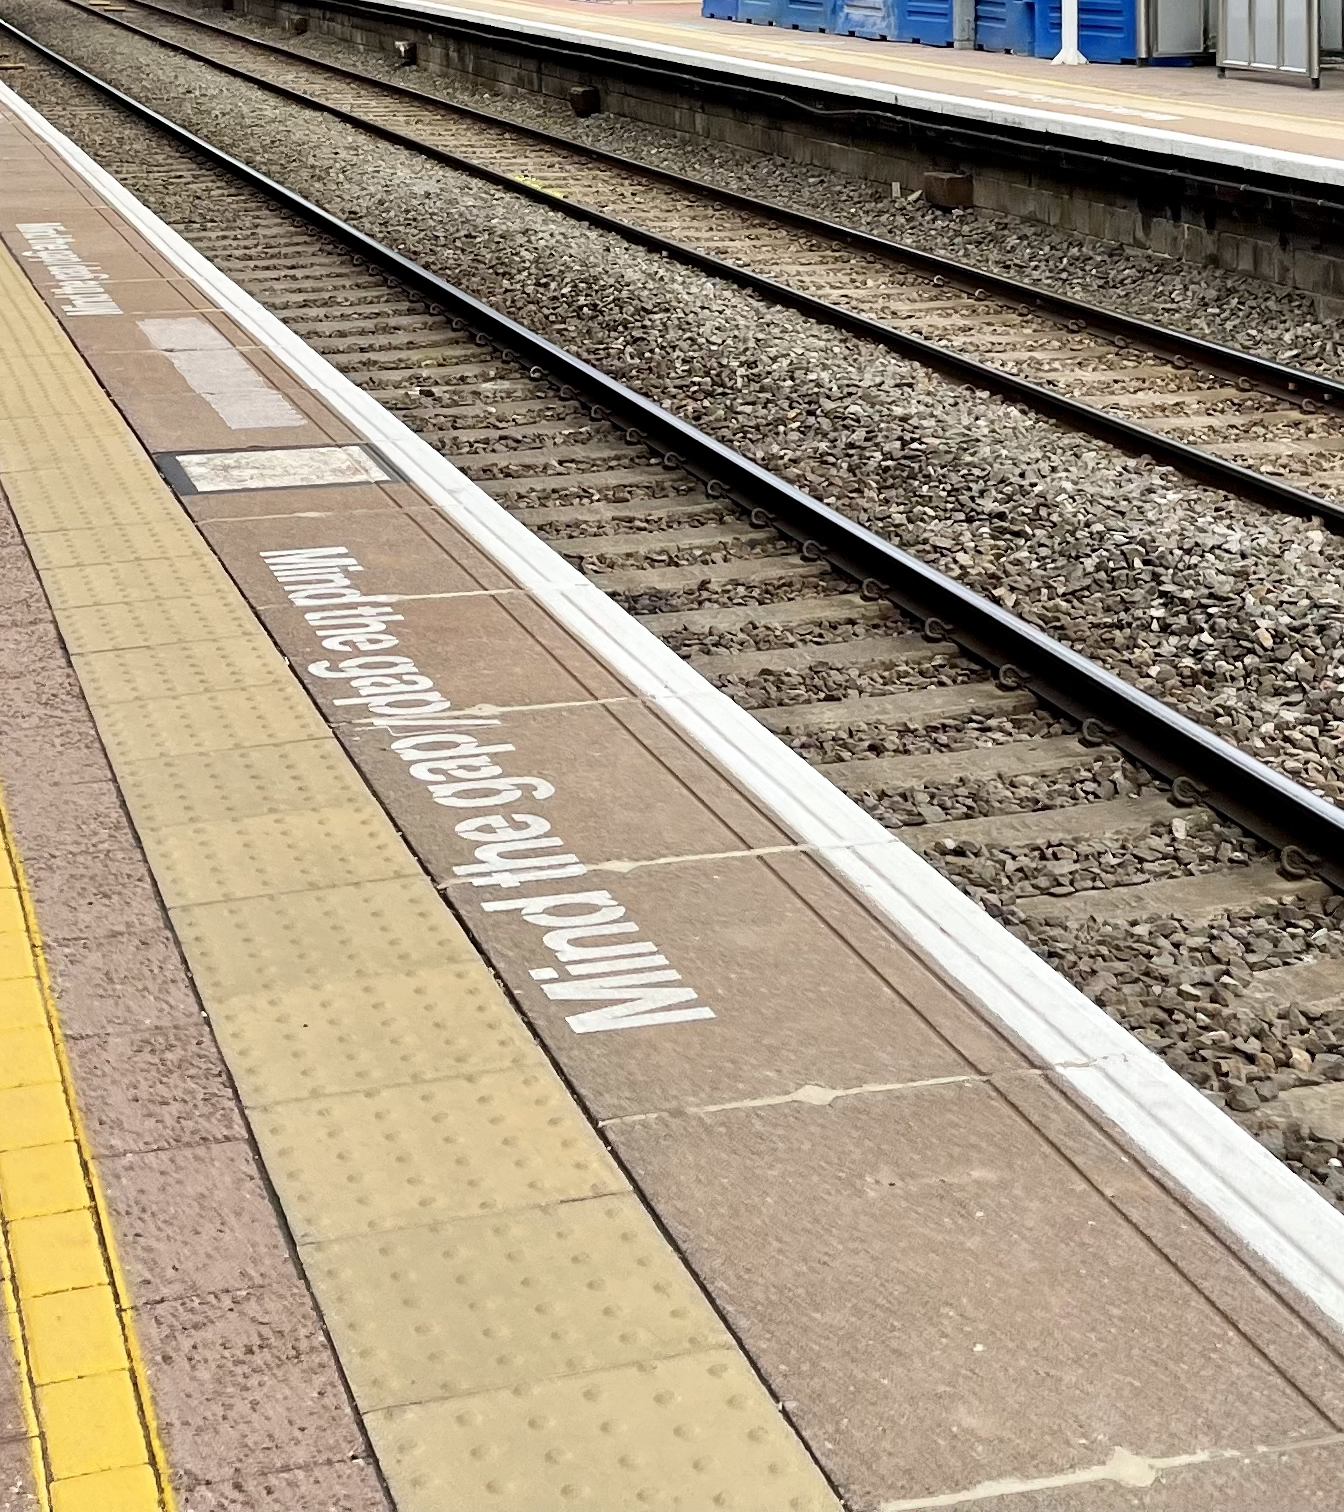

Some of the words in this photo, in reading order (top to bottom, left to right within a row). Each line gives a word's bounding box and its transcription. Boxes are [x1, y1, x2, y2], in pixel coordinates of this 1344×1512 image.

[260, 546, 396, 606] Mind
[304, 606, 404, 652] the
[453, 814, 588, 888] the
[481, 890, 716, 1034] Mind
